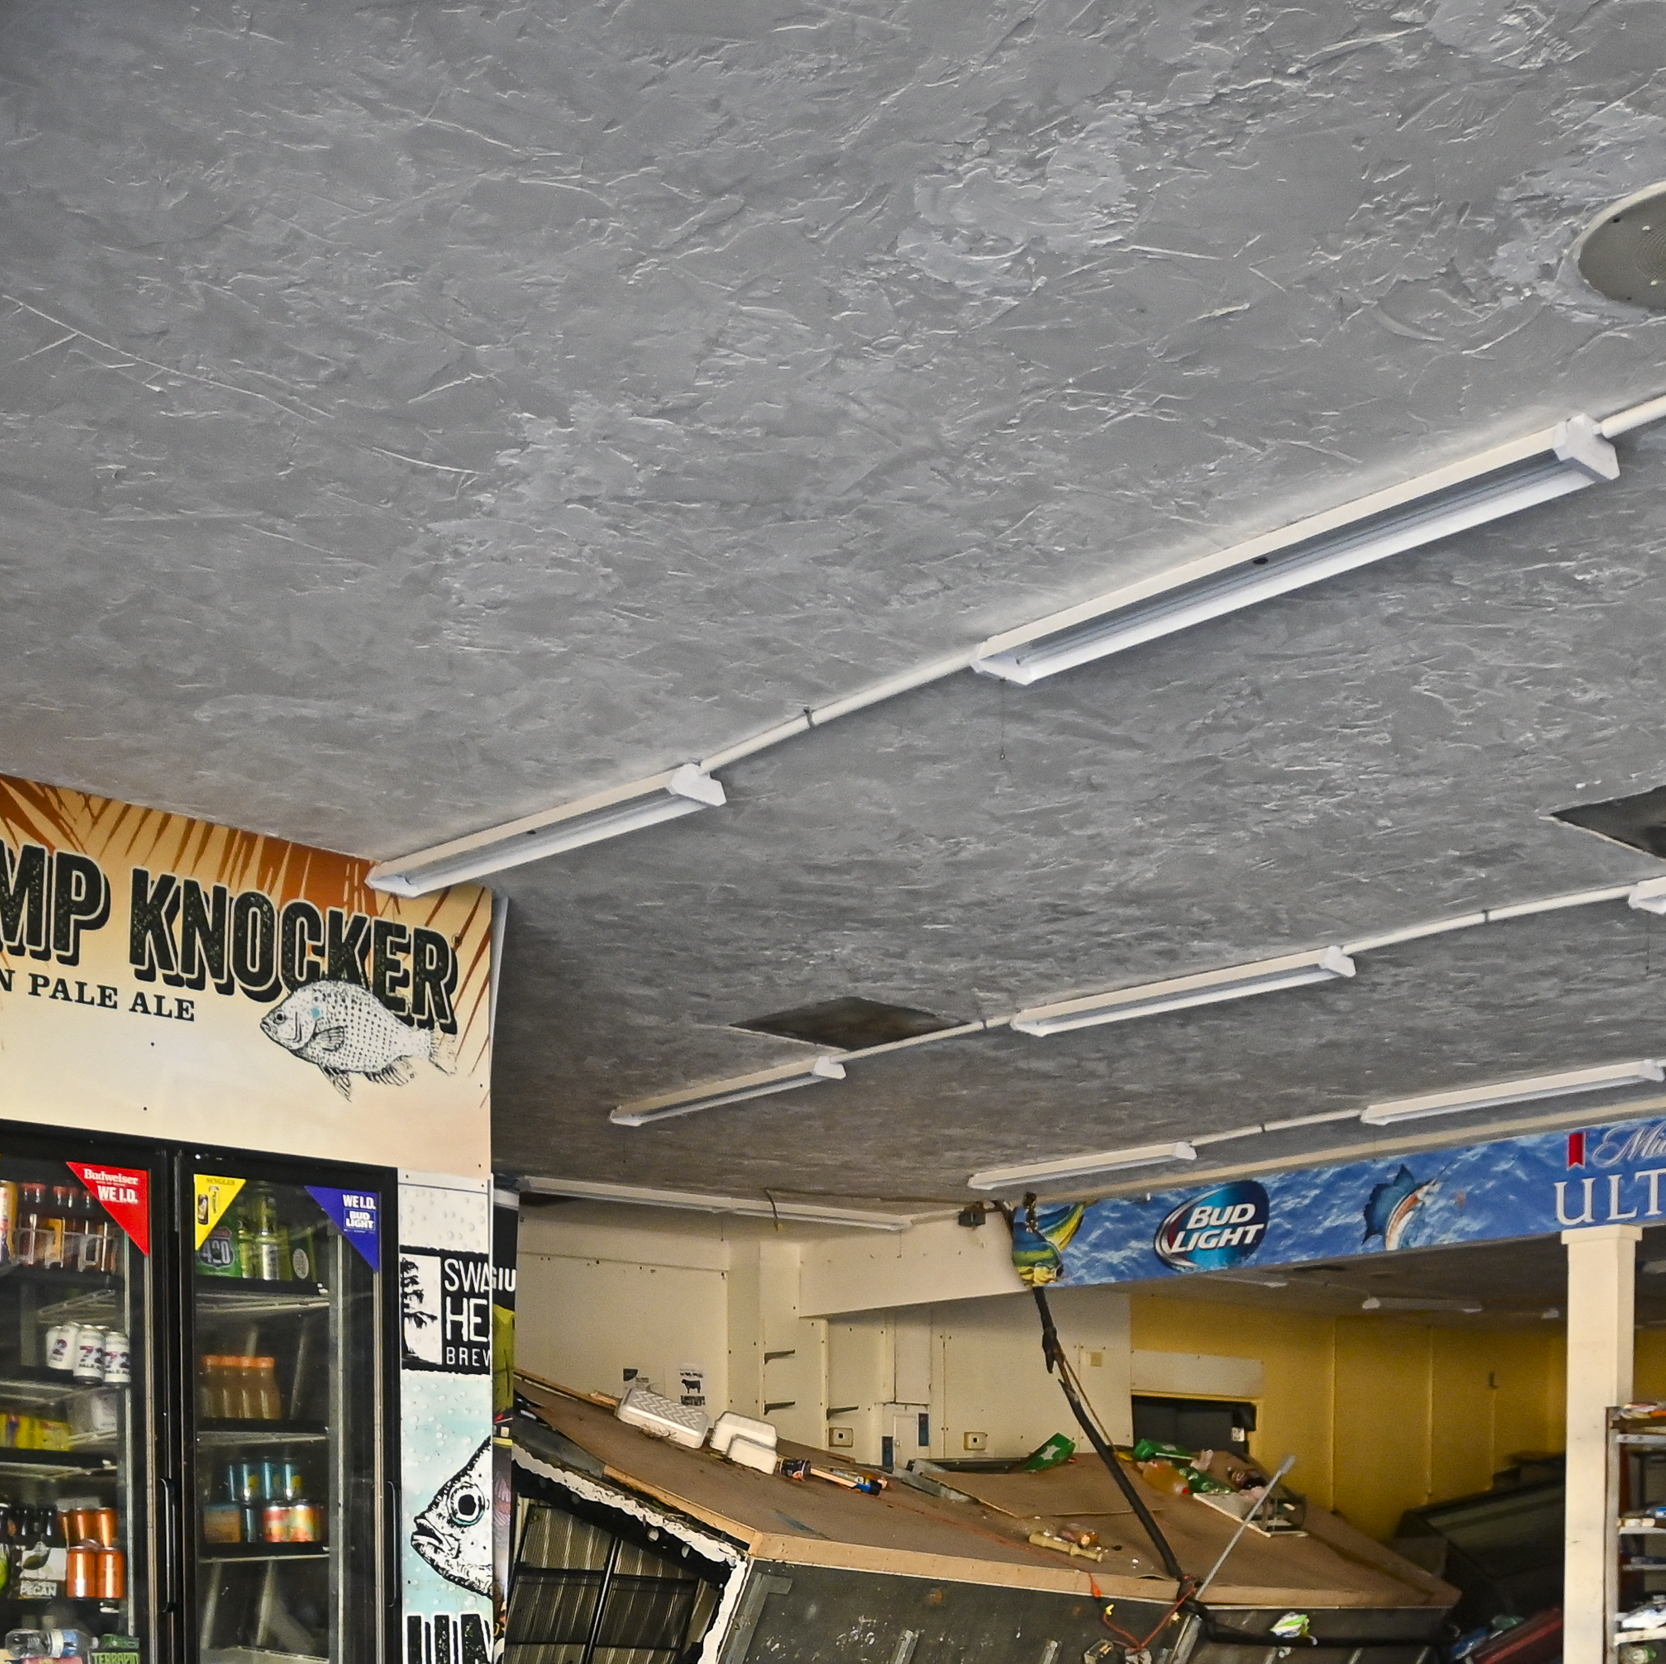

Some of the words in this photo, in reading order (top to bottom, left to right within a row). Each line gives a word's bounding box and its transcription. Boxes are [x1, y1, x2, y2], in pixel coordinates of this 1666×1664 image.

[129, 866, 459, 1034] KNOCKER
[28, 970, 118, 1010] PALE
[128, 993, 195, 1022] ALE
[84, 1167, 139, 1185] Budweiser
[97, 1186, 116, 1201] WE
[119, 1188, 139, 1204] I.D.
[343, 1193, 359, 1208] WE
[360, 1196, 376, 1209] I.D.
[345, 1218, 375, 1229] LIGHT
[349, 1210, 371, 1221] BUD
[1187, 1203, 1256, 1229] BUD
[1172, 1223, 1265, 1254] LIGHT
[202, 1239, 231, 1264] 420
[20, 1584, 57, 1597] PECAN
